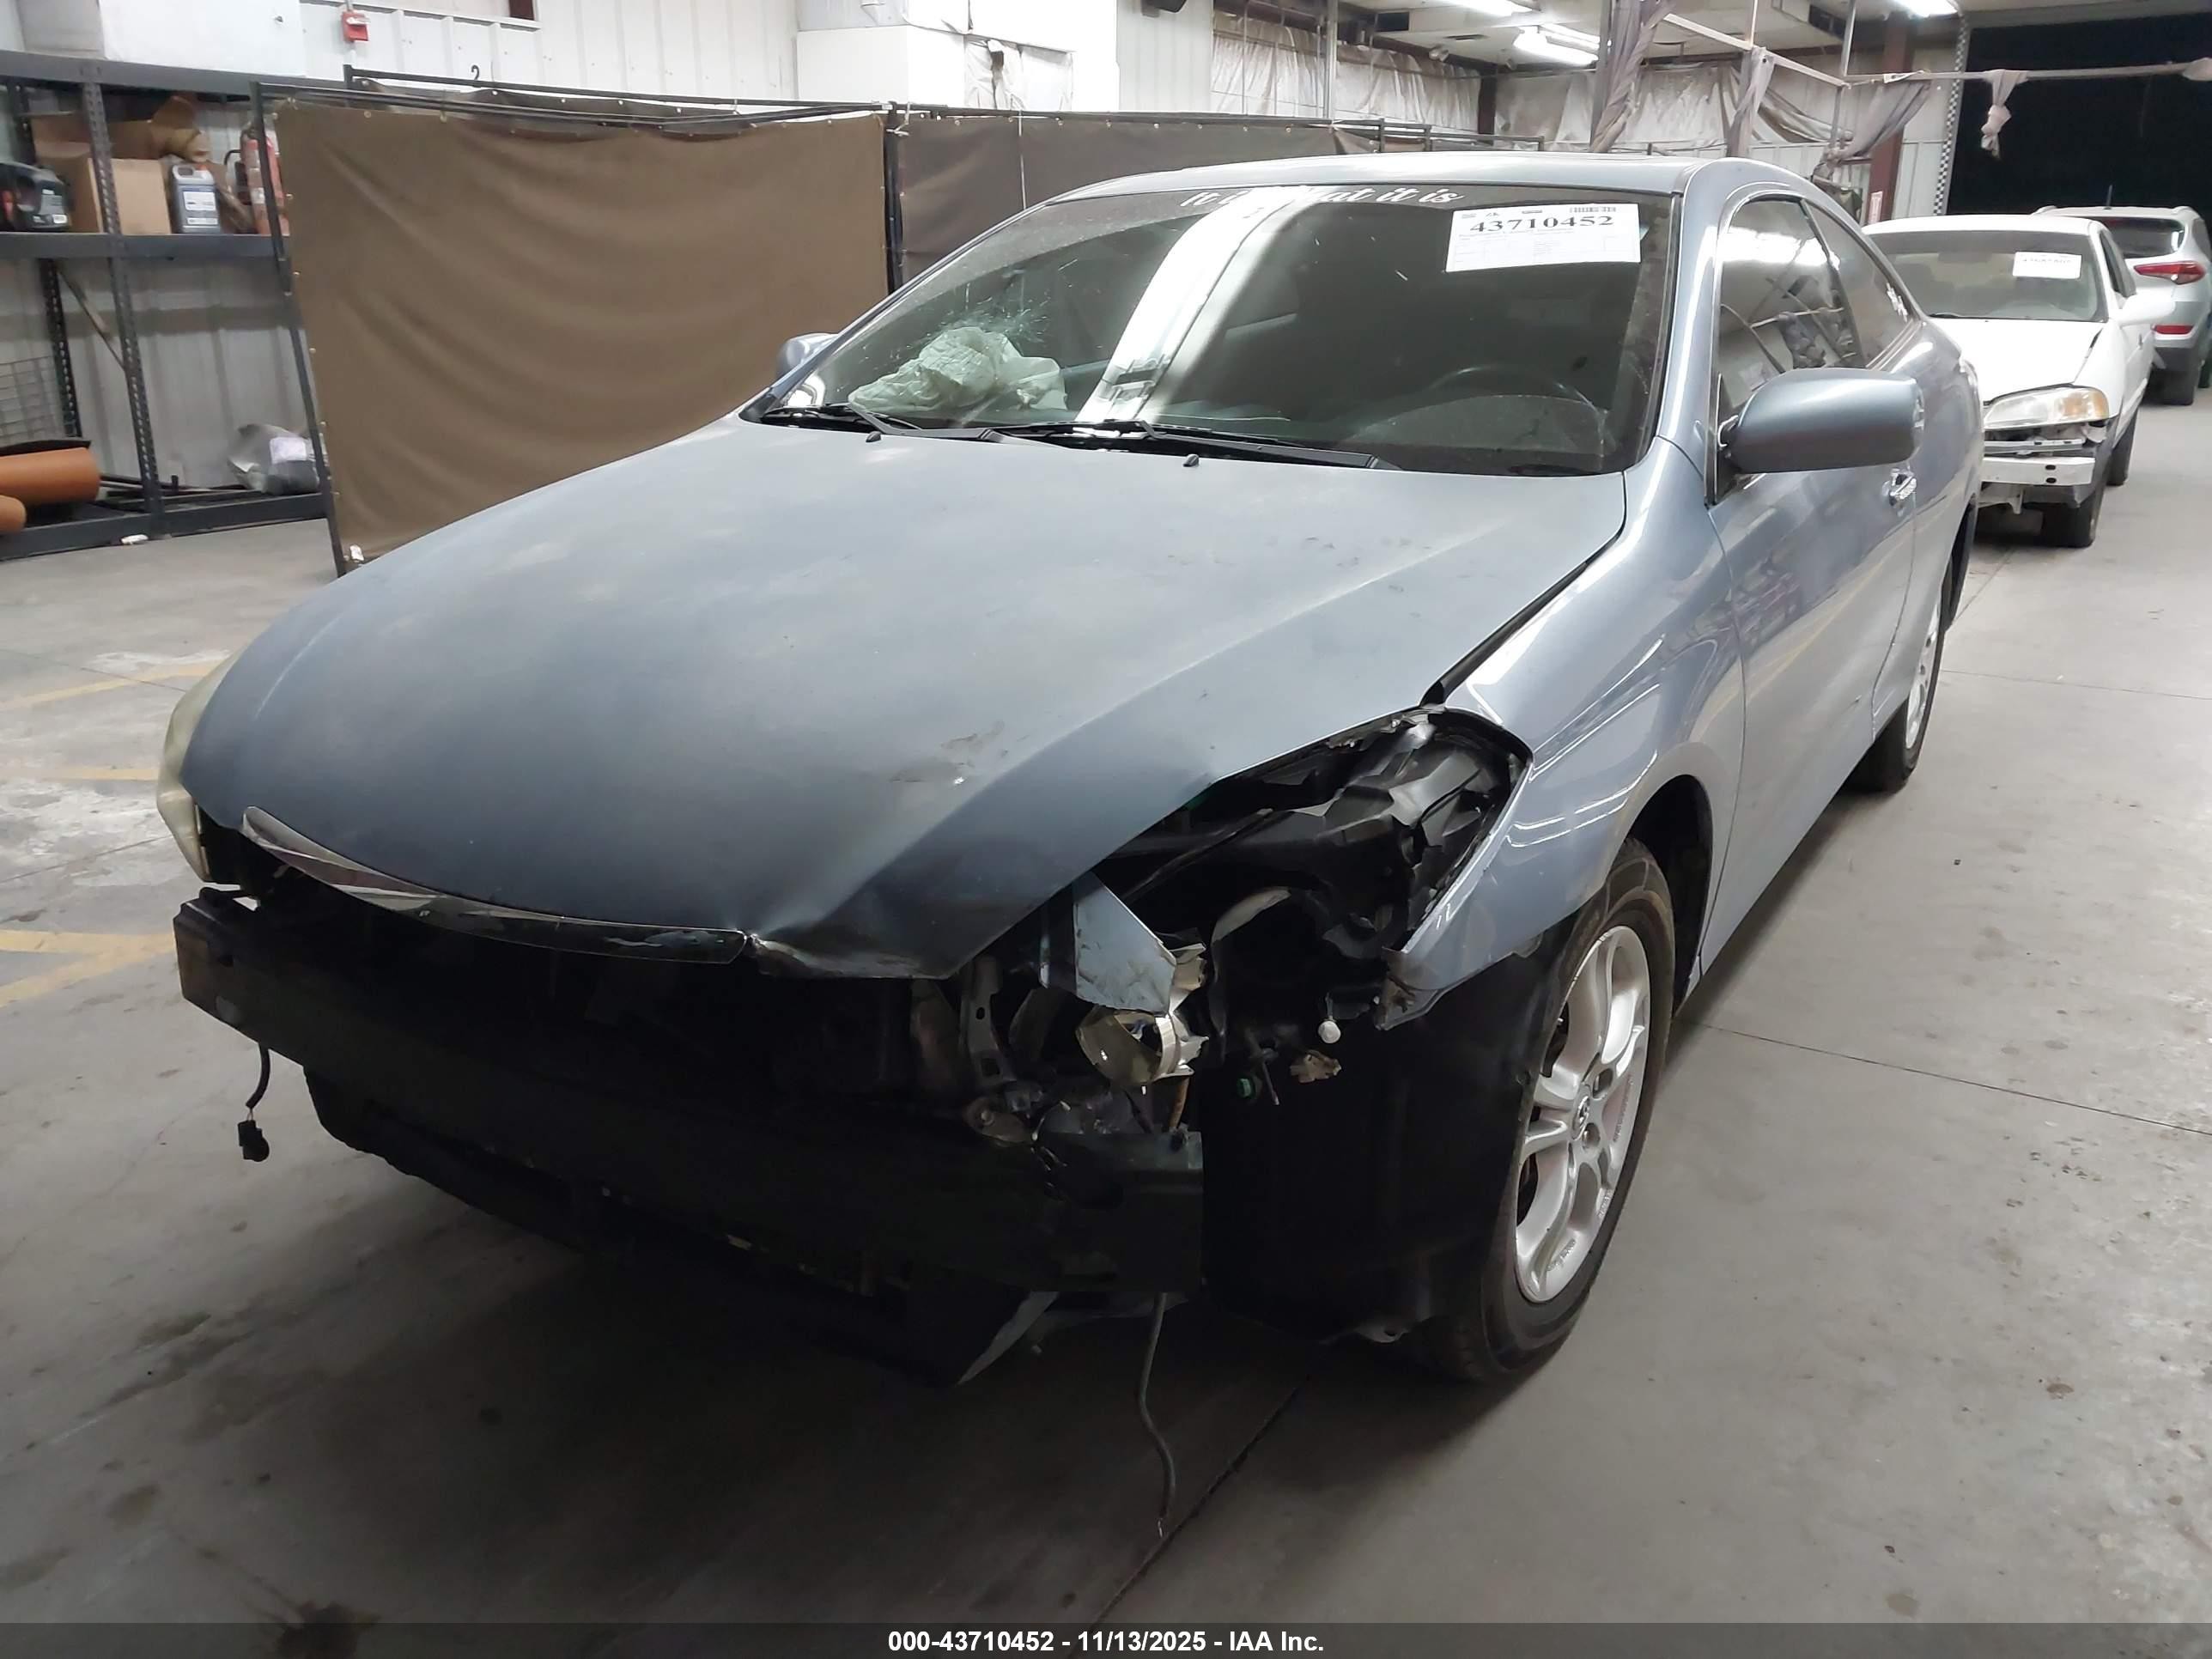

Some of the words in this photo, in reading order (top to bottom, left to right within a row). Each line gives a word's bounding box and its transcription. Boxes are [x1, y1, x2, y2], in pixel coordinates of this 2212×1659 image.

[1376, 187, 1419, 203] it
[1419, 188, 1465, 204] is
[1469, 216, 1614, 233] 43710452
